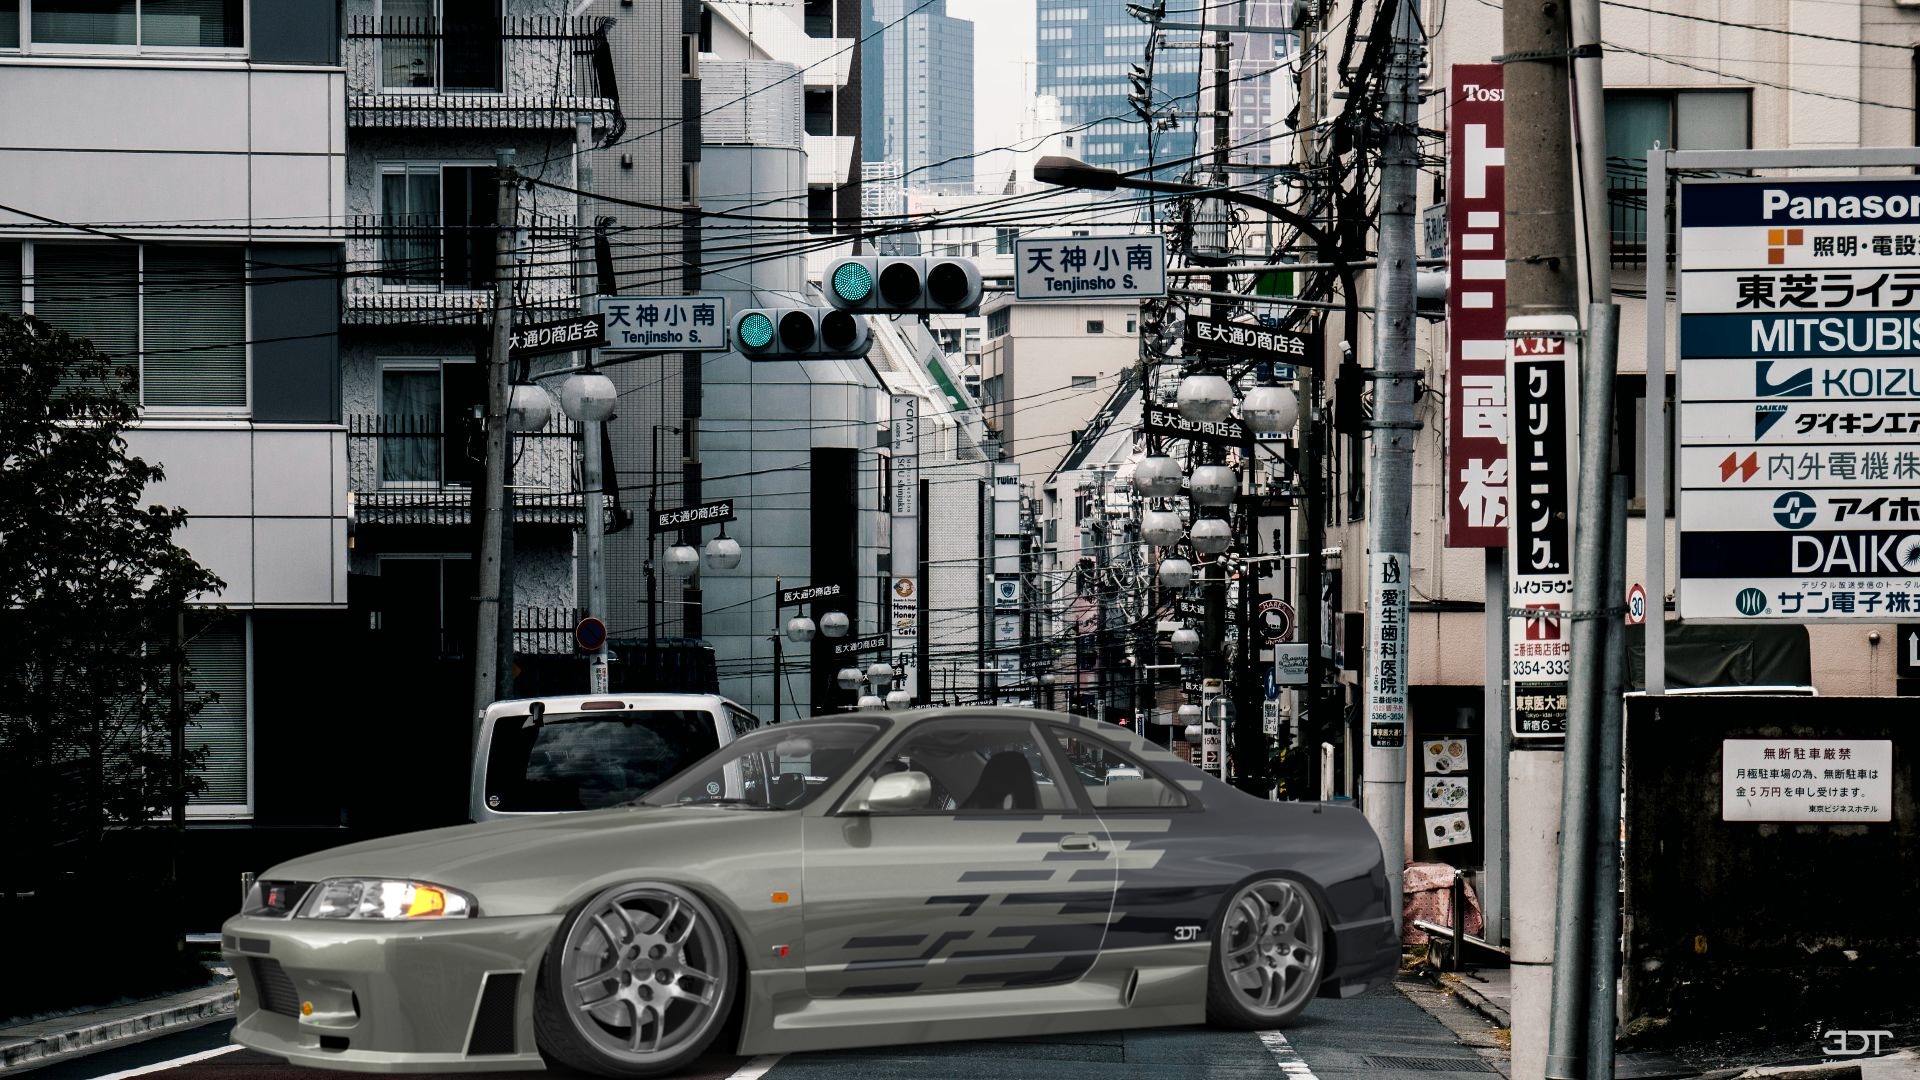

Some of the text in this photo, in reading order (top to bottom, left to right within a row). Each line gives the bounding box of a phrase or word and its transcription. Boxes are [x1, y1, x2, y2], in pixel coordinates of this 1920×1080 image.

[1813, 235, 1920, 257] 照明・電設
[1027, 243, 1153, 274] 天神小南
[1044, 273, 1138, 294] Tenjinsho S.
[607, 302, 717, 329] 天神小南
[621, 329, 702, 345] Tenjinsho S.
[1196, 320, 1306, 357] 医大通り商店会
[906, 399, 914, 443] LIVIDA
[1768, 451, 1920, 481] 内外電機株
[895, 479, 905, 513] shinjuku
[658, 503, 731, 527] 医大通り商店会
[783, 583, 841, 602] 医大通り商店会
[893, 603, 916, 611] Honey
[893, 611, 916, 619] Honey
[1631, 596, 1643, 617] 30
[898, 627, 916, 636] Café
[1380, 588, 1399, 694] 愛生歯科医院
[1763, 747, 1852, 761] 無断駐車厳禁
[1808, 804, 1879, 814] 東京ビジネスホテル
[1173, 925, 1202, 941] 3DT
